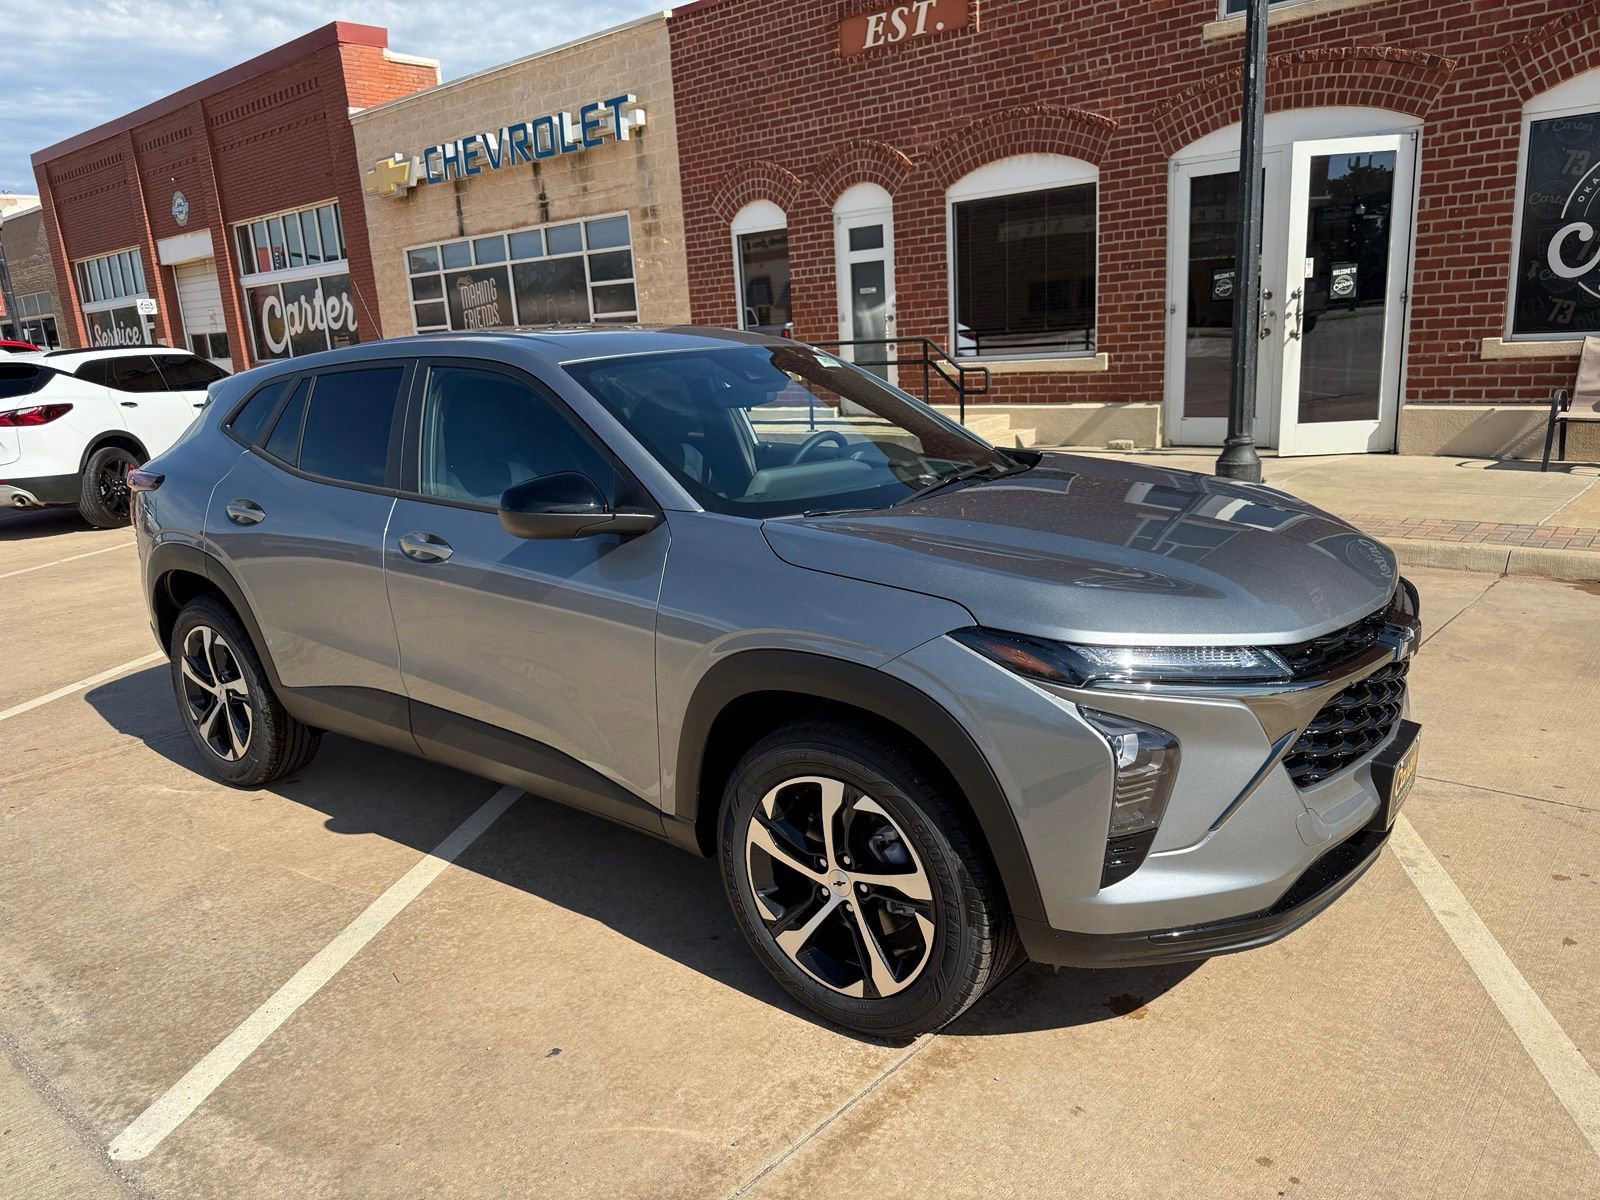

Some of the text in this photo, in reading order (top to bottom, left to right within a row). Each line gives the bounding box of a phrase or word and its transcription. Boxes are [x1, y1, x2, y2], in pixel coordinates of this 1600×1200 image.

[862, 0, 945, 49] EST.
[423, 94, 632, 184] CHEVROLET
[460, 277, 498, 309] MAKING
[94, 320, 142, 347] Service
[262, 287, 358, 354] Carter
